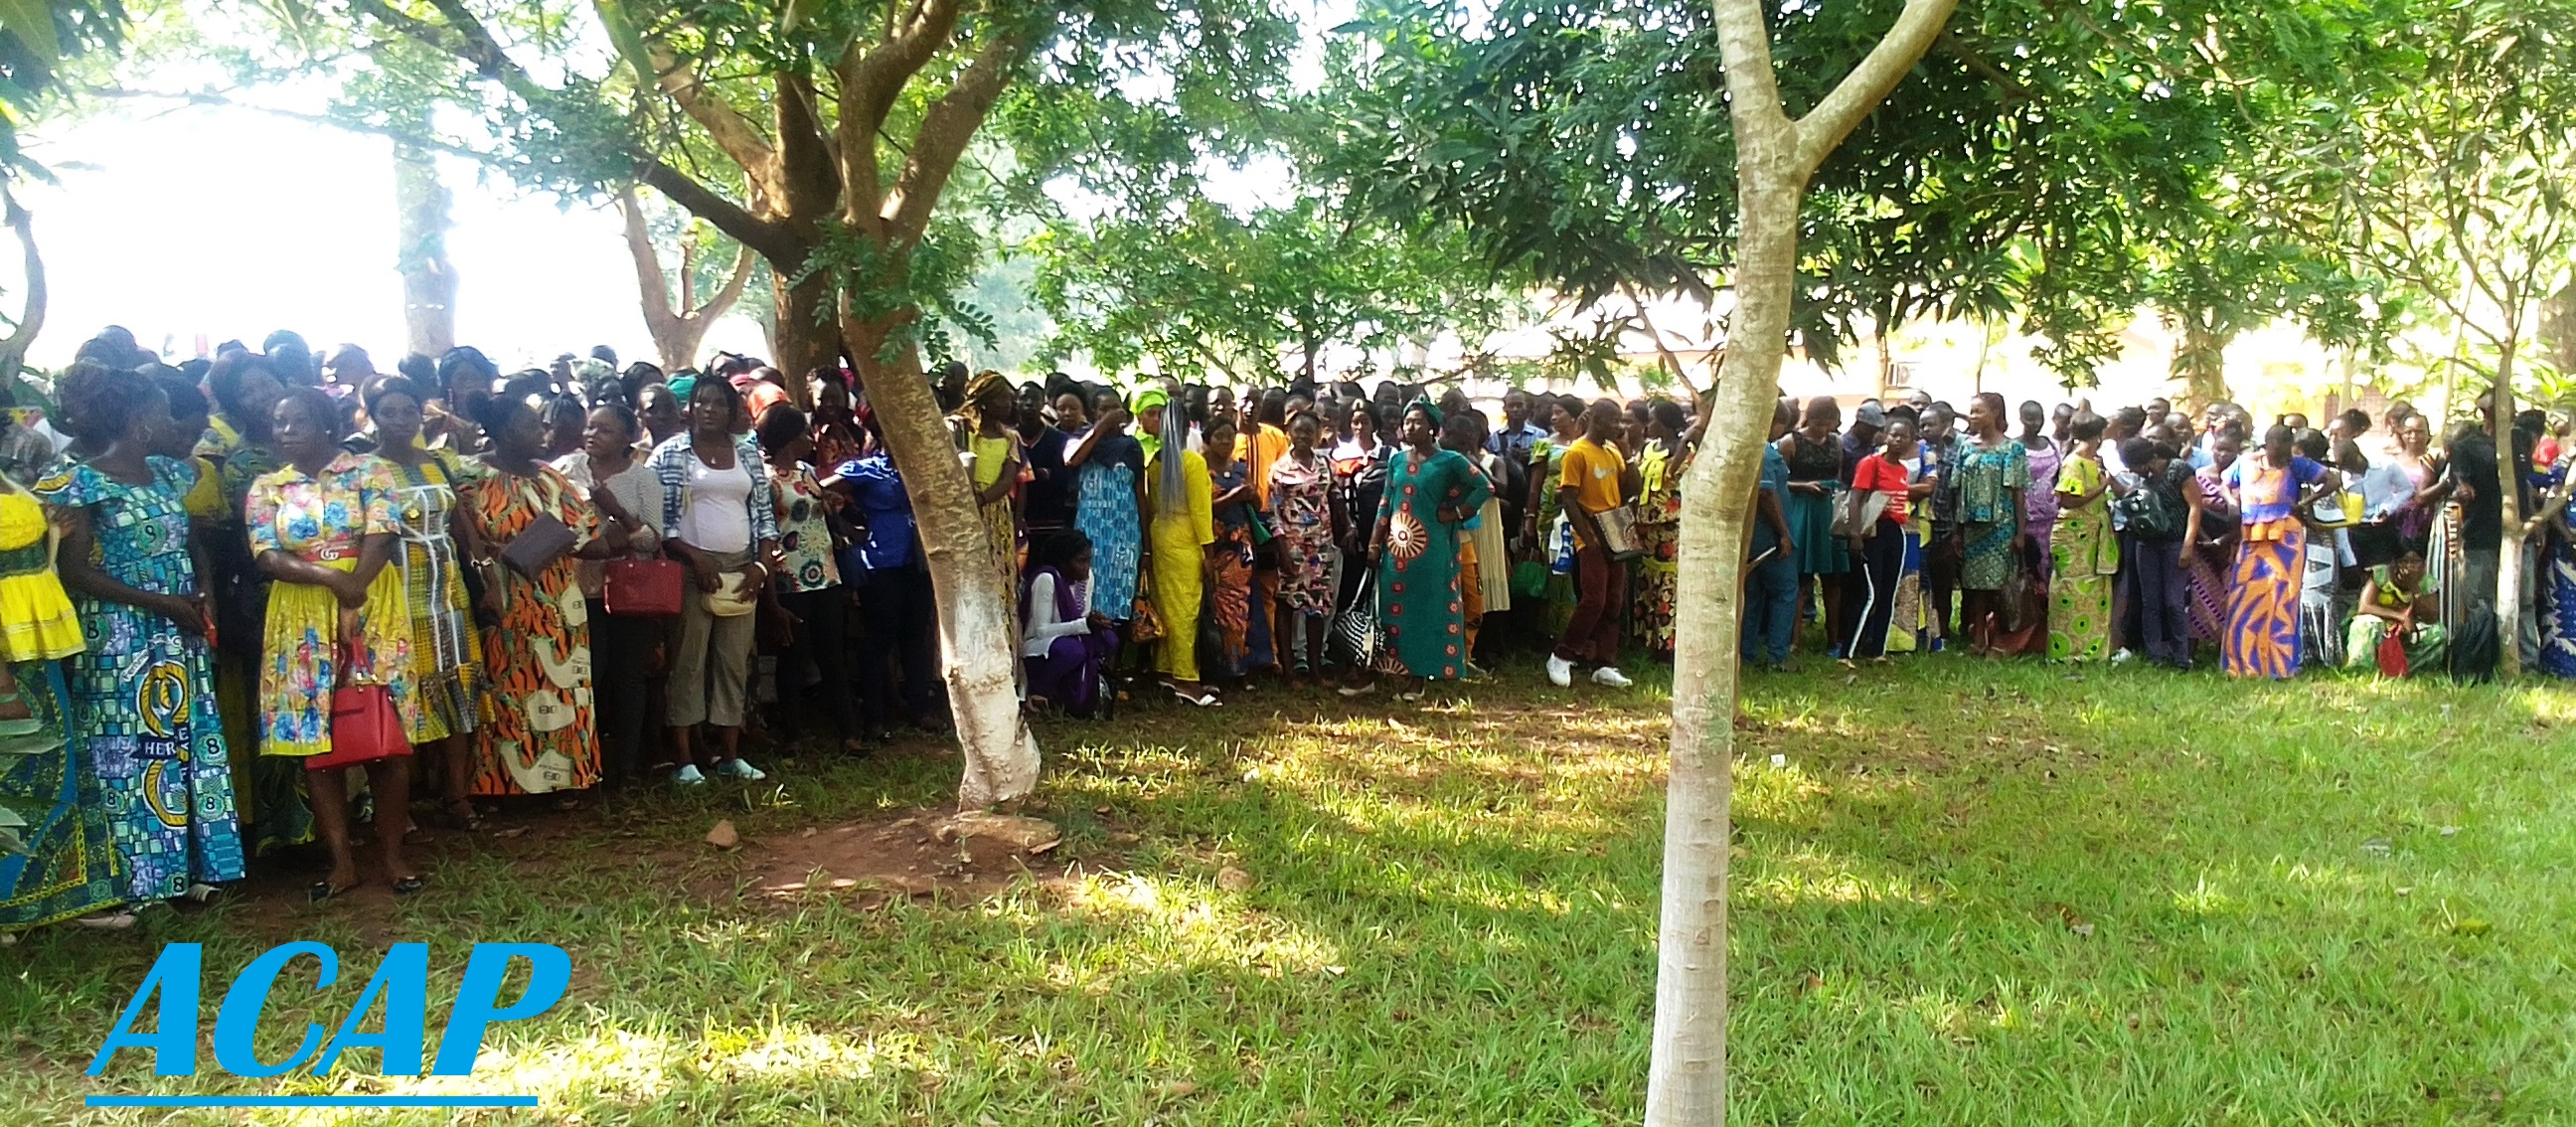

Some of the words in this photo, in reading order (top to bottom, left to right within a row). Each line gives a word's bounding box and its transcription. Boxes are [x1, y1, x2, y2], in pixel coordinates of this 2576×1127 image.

[206, 737, 221, 754] 8
[107, 793, 116, 805] 8
[205, 796, 216, 810] 8
[173, 876, 185, 893] 8
